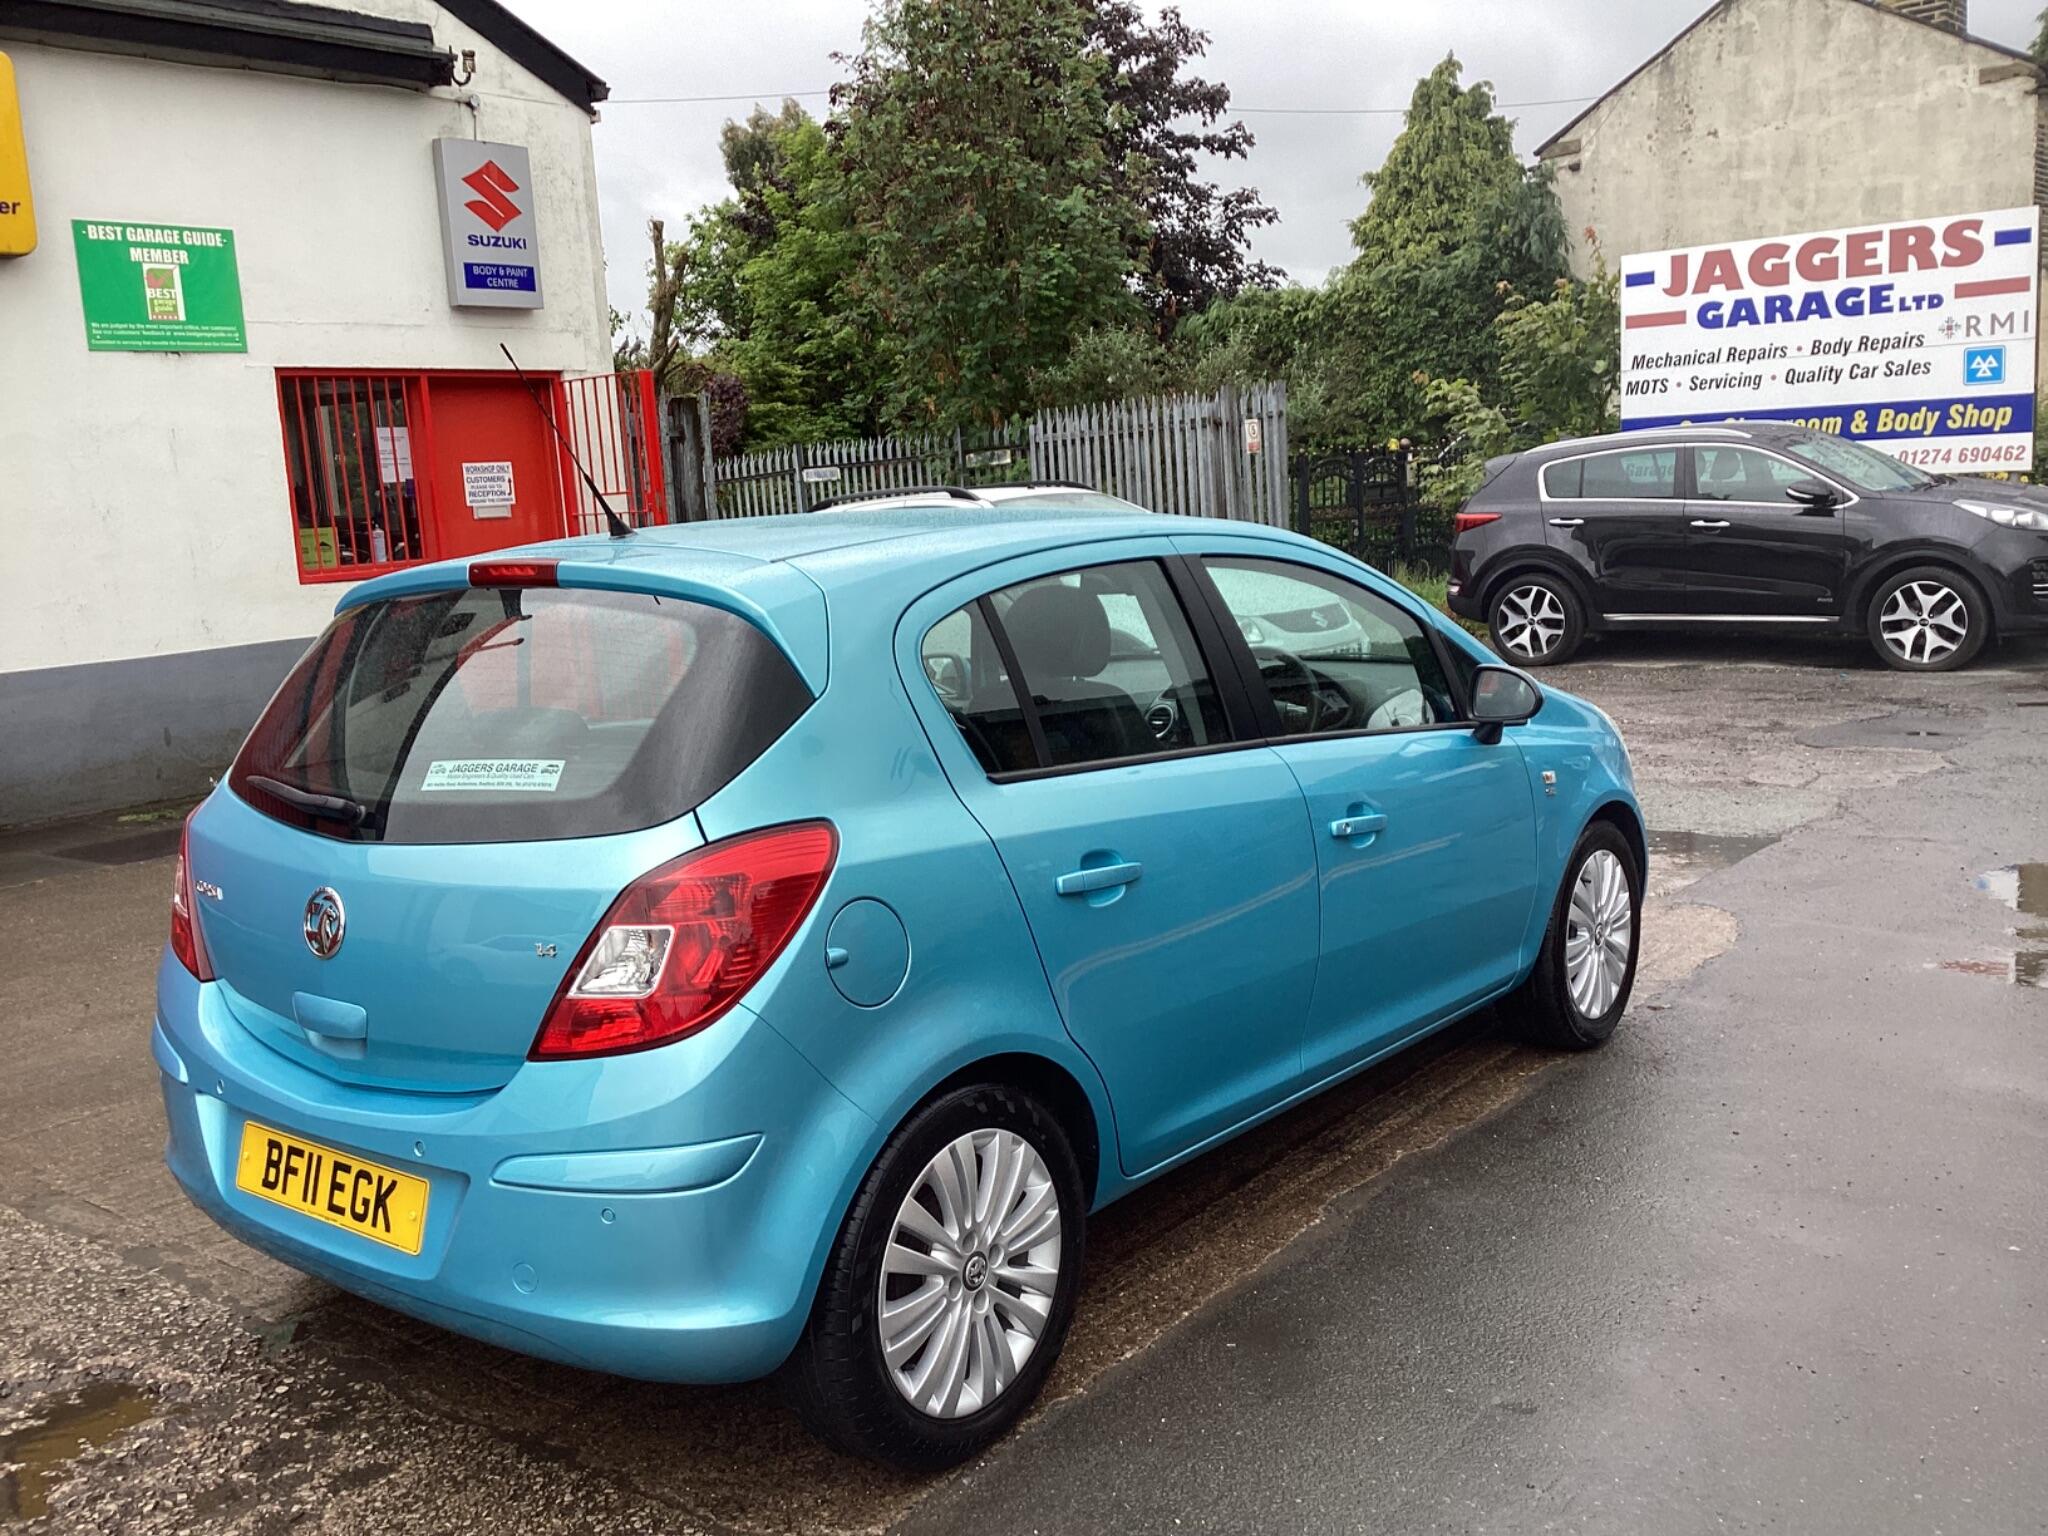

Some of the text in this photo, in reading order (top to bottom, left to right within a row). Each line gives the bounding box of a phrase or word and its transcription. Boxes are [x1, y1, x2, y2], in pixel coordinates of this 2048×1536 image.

[87, 224, 223, 247] BEST GARAGE GUIDE
[467, 234, 527, 250] SUZUKI
[129, 247, 189, 264] MEMBER
[1662, 219, 1985, 297] JAGGERS
[473, 265, 528, 277] BODY & PAINT
[486, 278, 519, 288] CENTRE
[149, 288, 177, 299] BEST
[1697, 283, 1945, 329] GARAGE LTD
[1965, 310, 2030, 337] RMI
[1631, 332, 1925, 370] Mechanical Repairs Body Repairs
[1625, 359, 1932, 396] MOTS Servicing Quality Car Sales
[1850, 410, 1868, 434] &
[1876, 406, 1941, 435] Body
[1946, 403, 2013, 431] Shop
[1898, 445, 2026, 465] 01274 690462
[465, 464, 509, 473] WORKSHOP ONLY
[466, 475, 505, 483] CUSTOMERS
[448, 763, 540, 774] JAGGERS GARAGE
[261, 1137, 398, 1234] BF11 EGK
